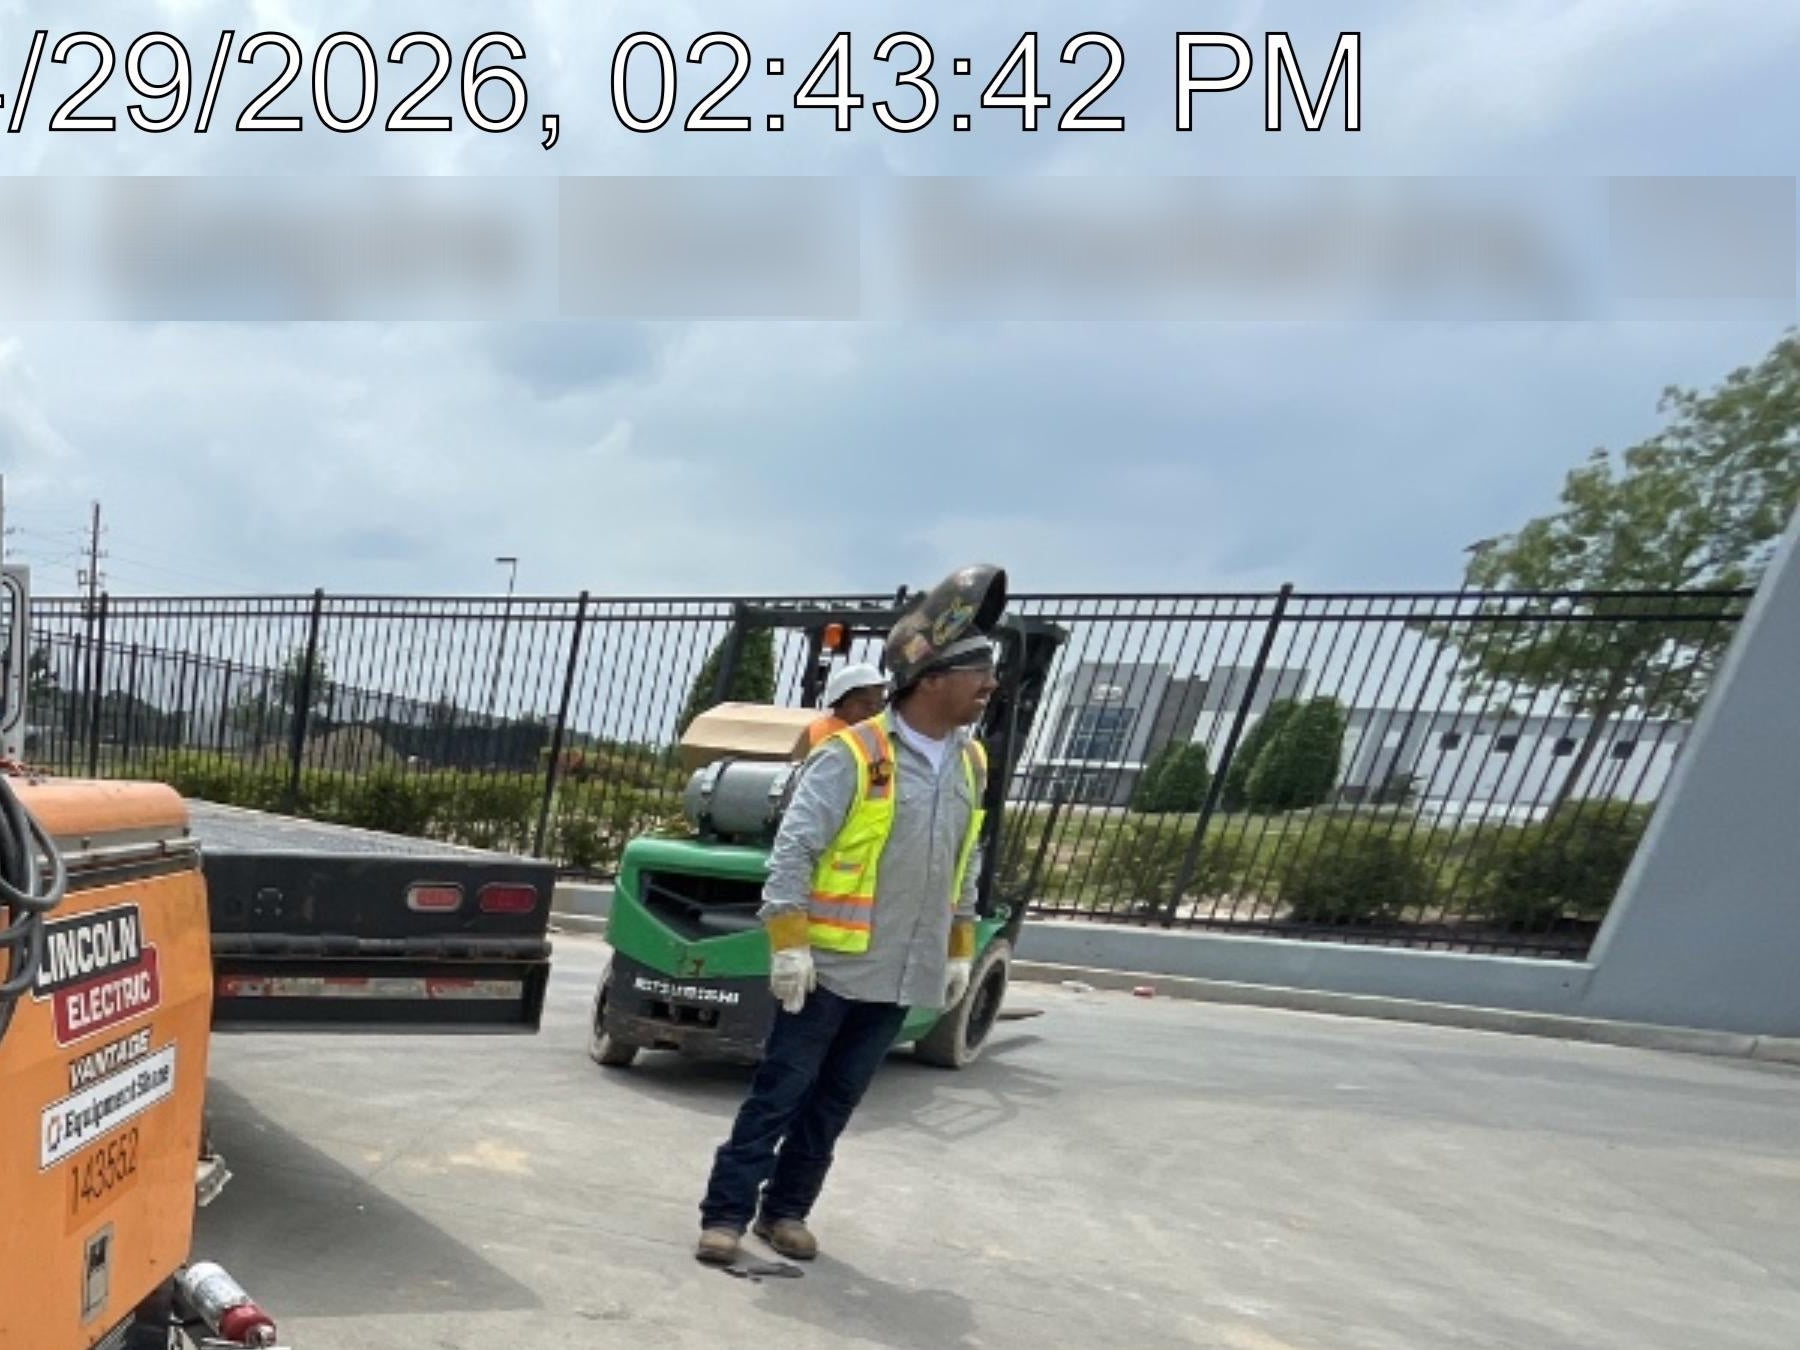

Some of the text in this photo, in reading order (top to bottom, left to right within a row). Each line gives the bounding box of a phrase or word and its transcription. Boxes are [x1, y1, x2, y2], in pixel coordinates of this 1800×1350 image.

[66, 970, 152, 1031] ELECTRIC
[68, 1024, 153, 1091] VANTAGE
[71, 1126, 140, 1216] 143552
